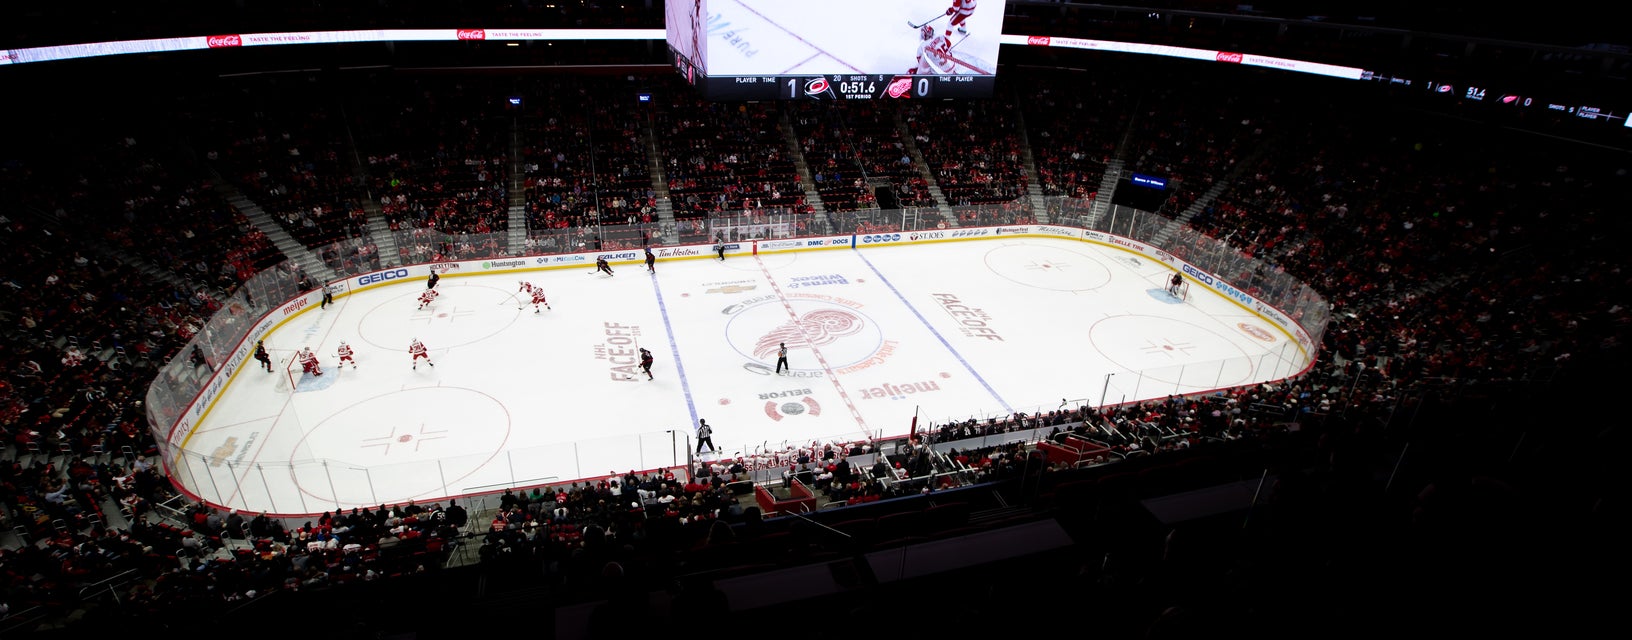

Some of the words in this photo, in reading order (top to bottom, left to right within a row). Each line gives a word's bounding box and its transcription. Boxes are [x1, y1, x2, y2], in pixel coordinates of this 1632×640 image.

[208, 35, 239, 46] Coca-Cola
[458, 30, 484, 39] Coca-Cola
[788, 79, 796, 98] 1
[840, 82, 876, 94] 0:51.6
[917, 78, 929, 97] 0
[1524, 98, 1532, 106] 0
[658, 249, 671, 257] Tim
[672, 247, 700, 257] Hortons
[1114, 239, 1130, 247] BELLE
[1132, 244, 1144, 252] TIRE
[491, 260, 525, 268] Huntington
[358, 268, 408, 286] GEICO
[790, 273, 845, 282] Wilcox
[1182, 263, 1213, 286] GEICO
[801, 278, 849, 287] Burns
[282, 297, 308, 316] meijer
[931, 292, 1005, 341] FACE-OFF
[593, 343, 607, 360] NHL
[604, 321, 640, 382] FACE-OFF
[758, 388, 813, 400] BELFOR
[859, 379, 941, 401] meijer
